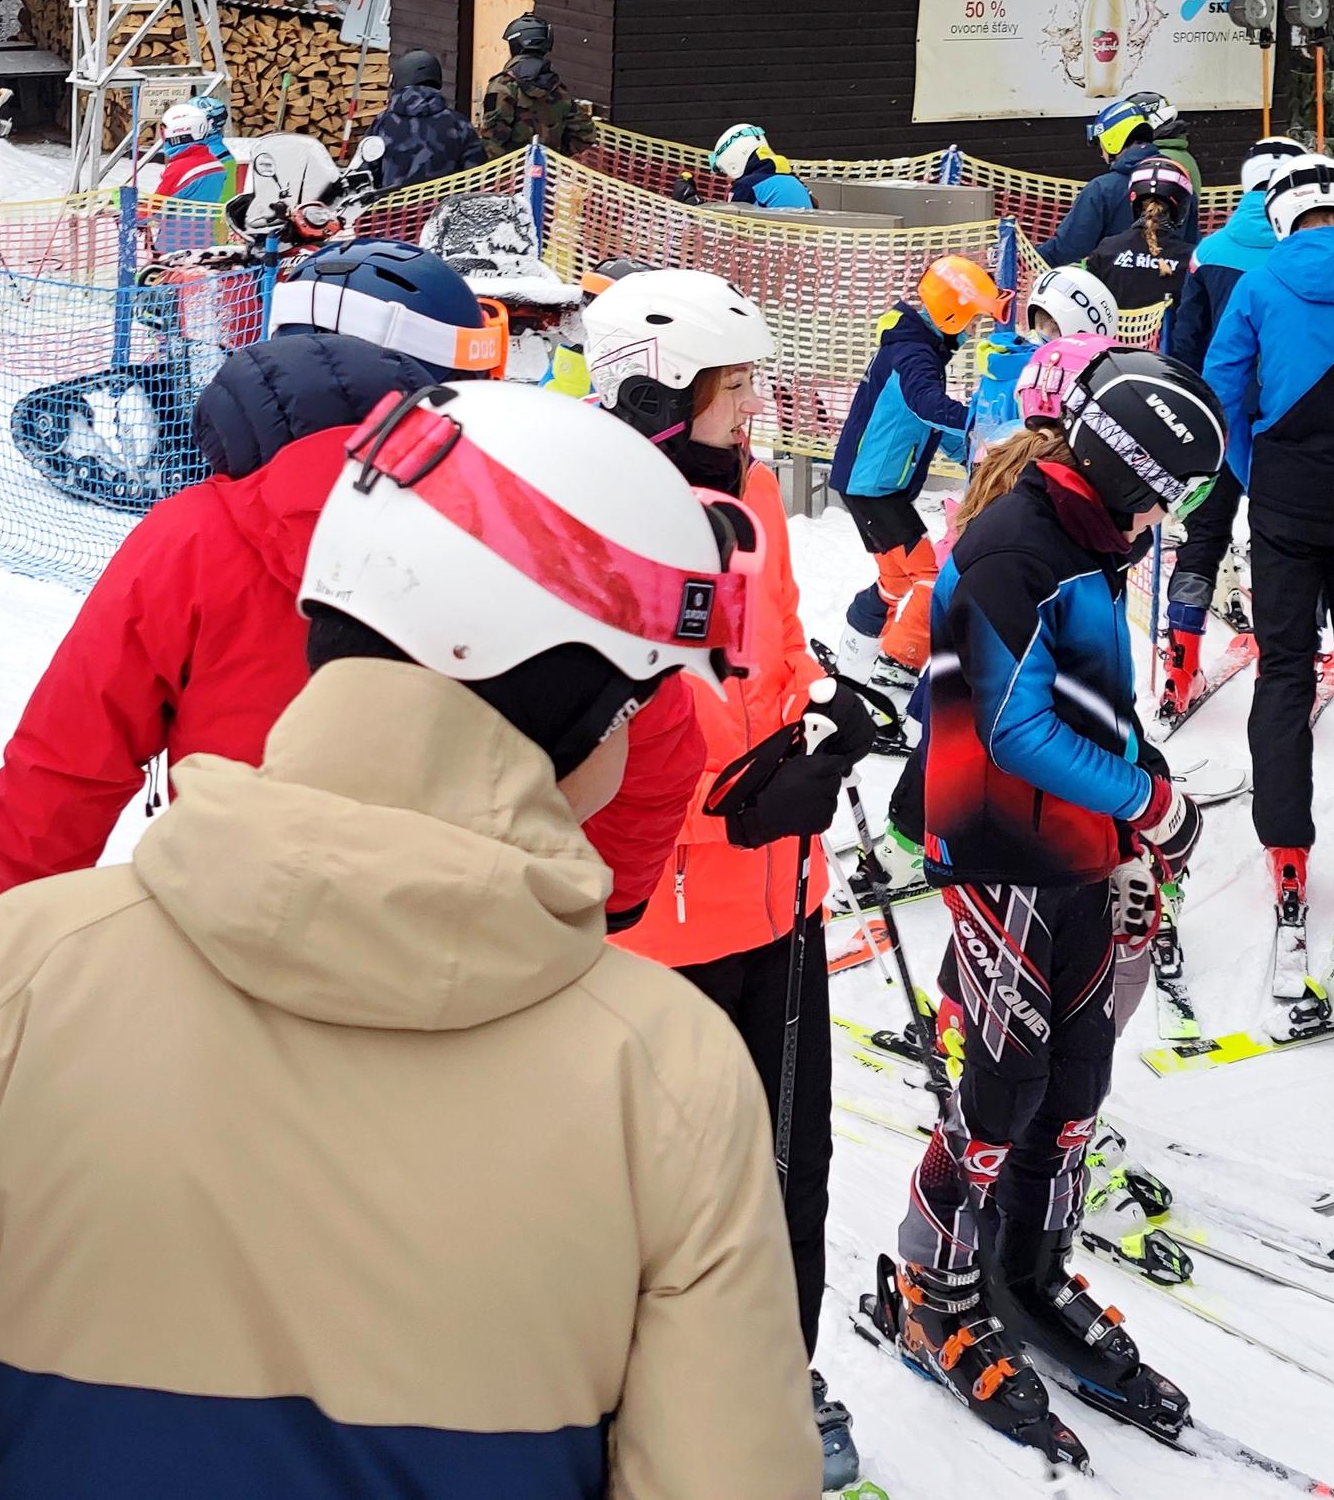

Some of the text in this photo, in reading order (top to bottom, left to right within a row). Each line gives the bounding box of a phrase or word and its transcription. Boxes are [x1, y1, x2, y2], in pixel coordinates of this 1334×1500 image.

[965, 0, 1006, 18] 50 %
[950, 20, 1019, 35] ovocné šťávy
[1145, 392, 1189, 439] VOLA
[958, 919, 1003, 979] DON
